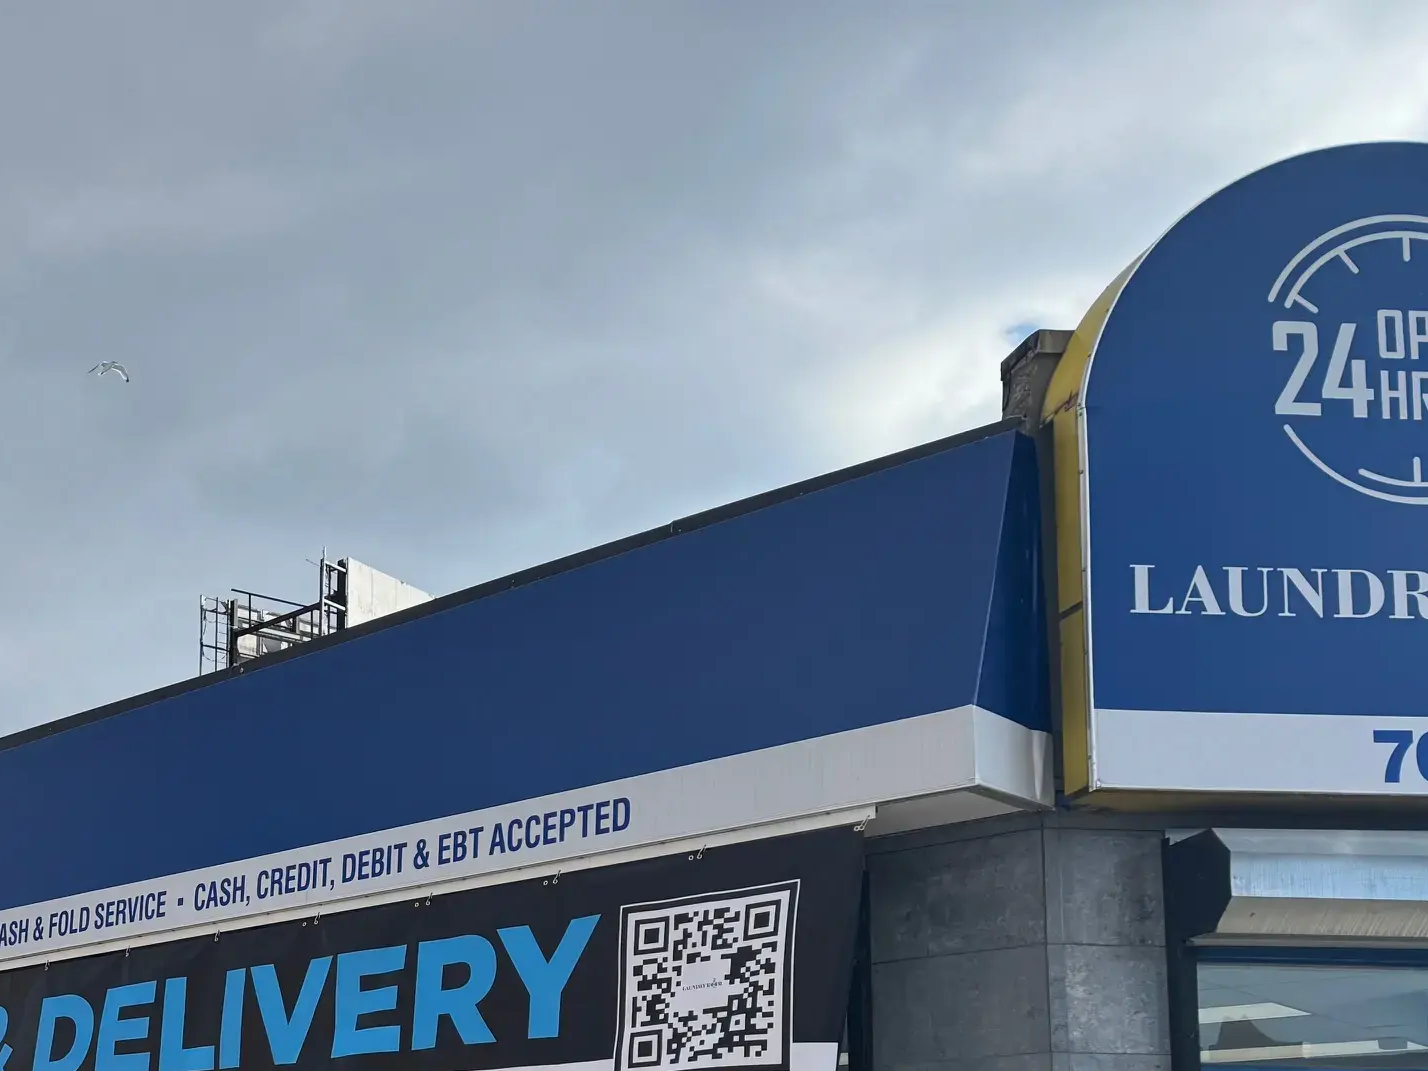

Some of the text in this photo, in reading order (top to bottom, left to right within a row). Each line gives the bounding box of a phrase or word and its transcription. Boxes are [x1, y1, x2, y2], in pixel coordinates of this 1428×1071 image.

[1272, 320, 1375, 418] 24
[33, 916, 44, 941] &
[48, 906, 90, 938] FOLD
[94, 890, 167, 930] SERVICE
[193, 876, 251, 912] CASH,
[256, 857, 335, 900] CREDIT,
[341, 842, 408, 884] DEBIT
[413, 838, 430, 869] &
[437, 826, 484, 865] EBT
[488, 797, 631, 856] ACCEPTED
